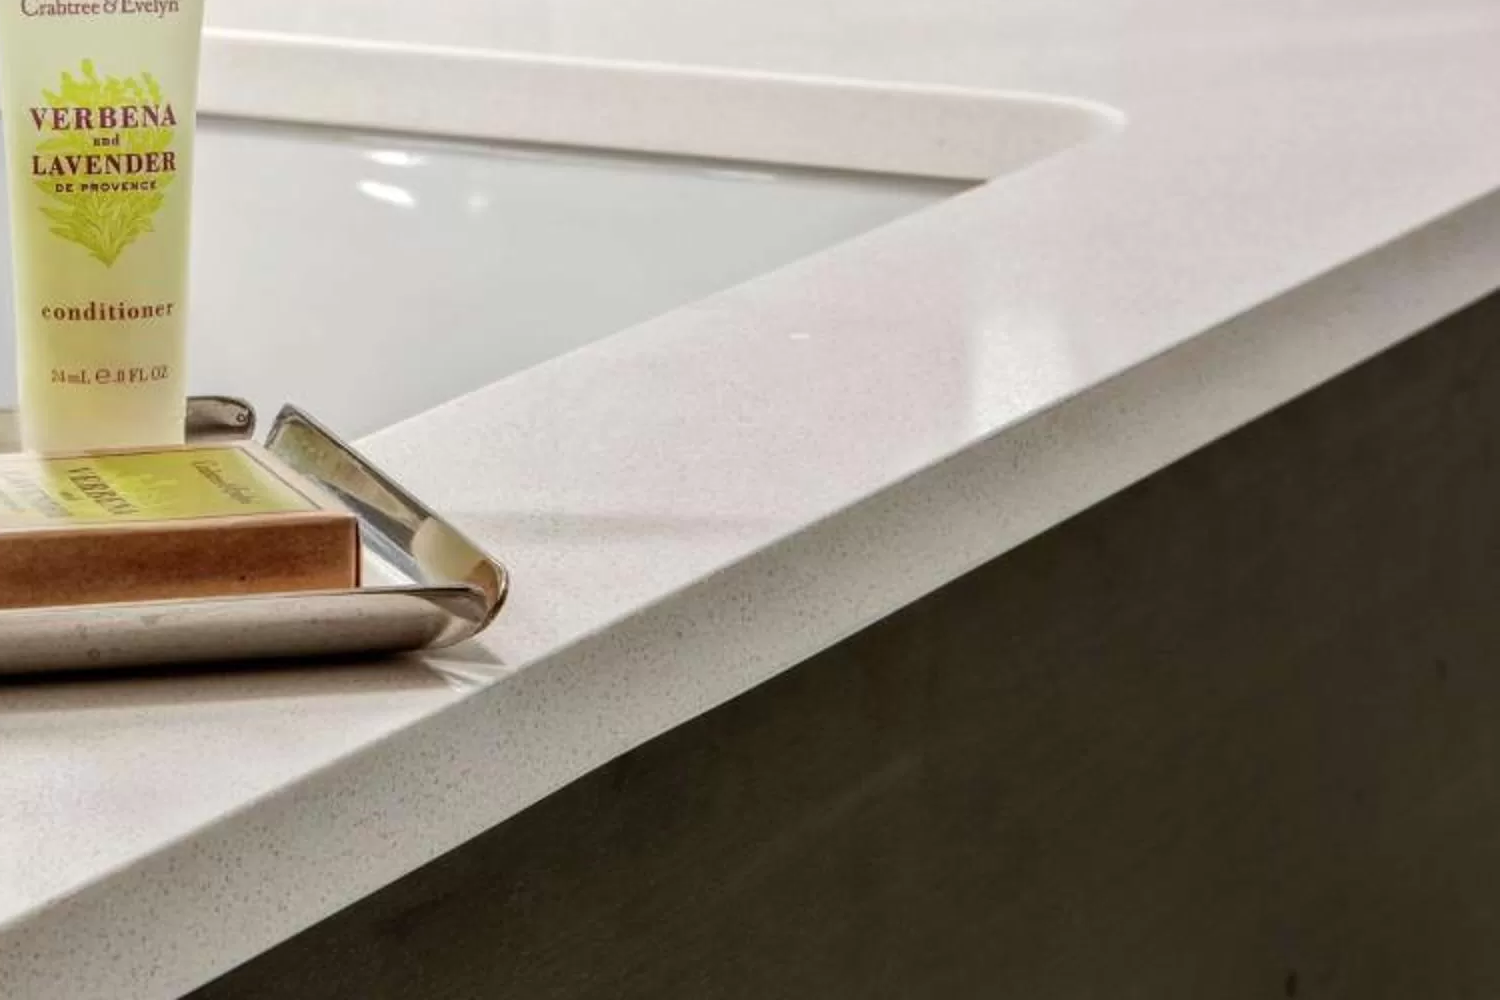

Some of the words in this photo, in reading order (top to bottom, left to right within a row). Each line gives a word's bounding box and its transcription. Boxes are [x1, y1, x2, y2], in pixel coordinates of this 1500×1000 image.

[30, 104, 177, 131] VERBENA
[93, 134, 120, 146] and
[32, 151, 176, 175] LAVENDER
[55, 183, 73, 192] DE
[81, 180, 157, 192] PROVENCE
[41, 301, 174, 321] conditioner
